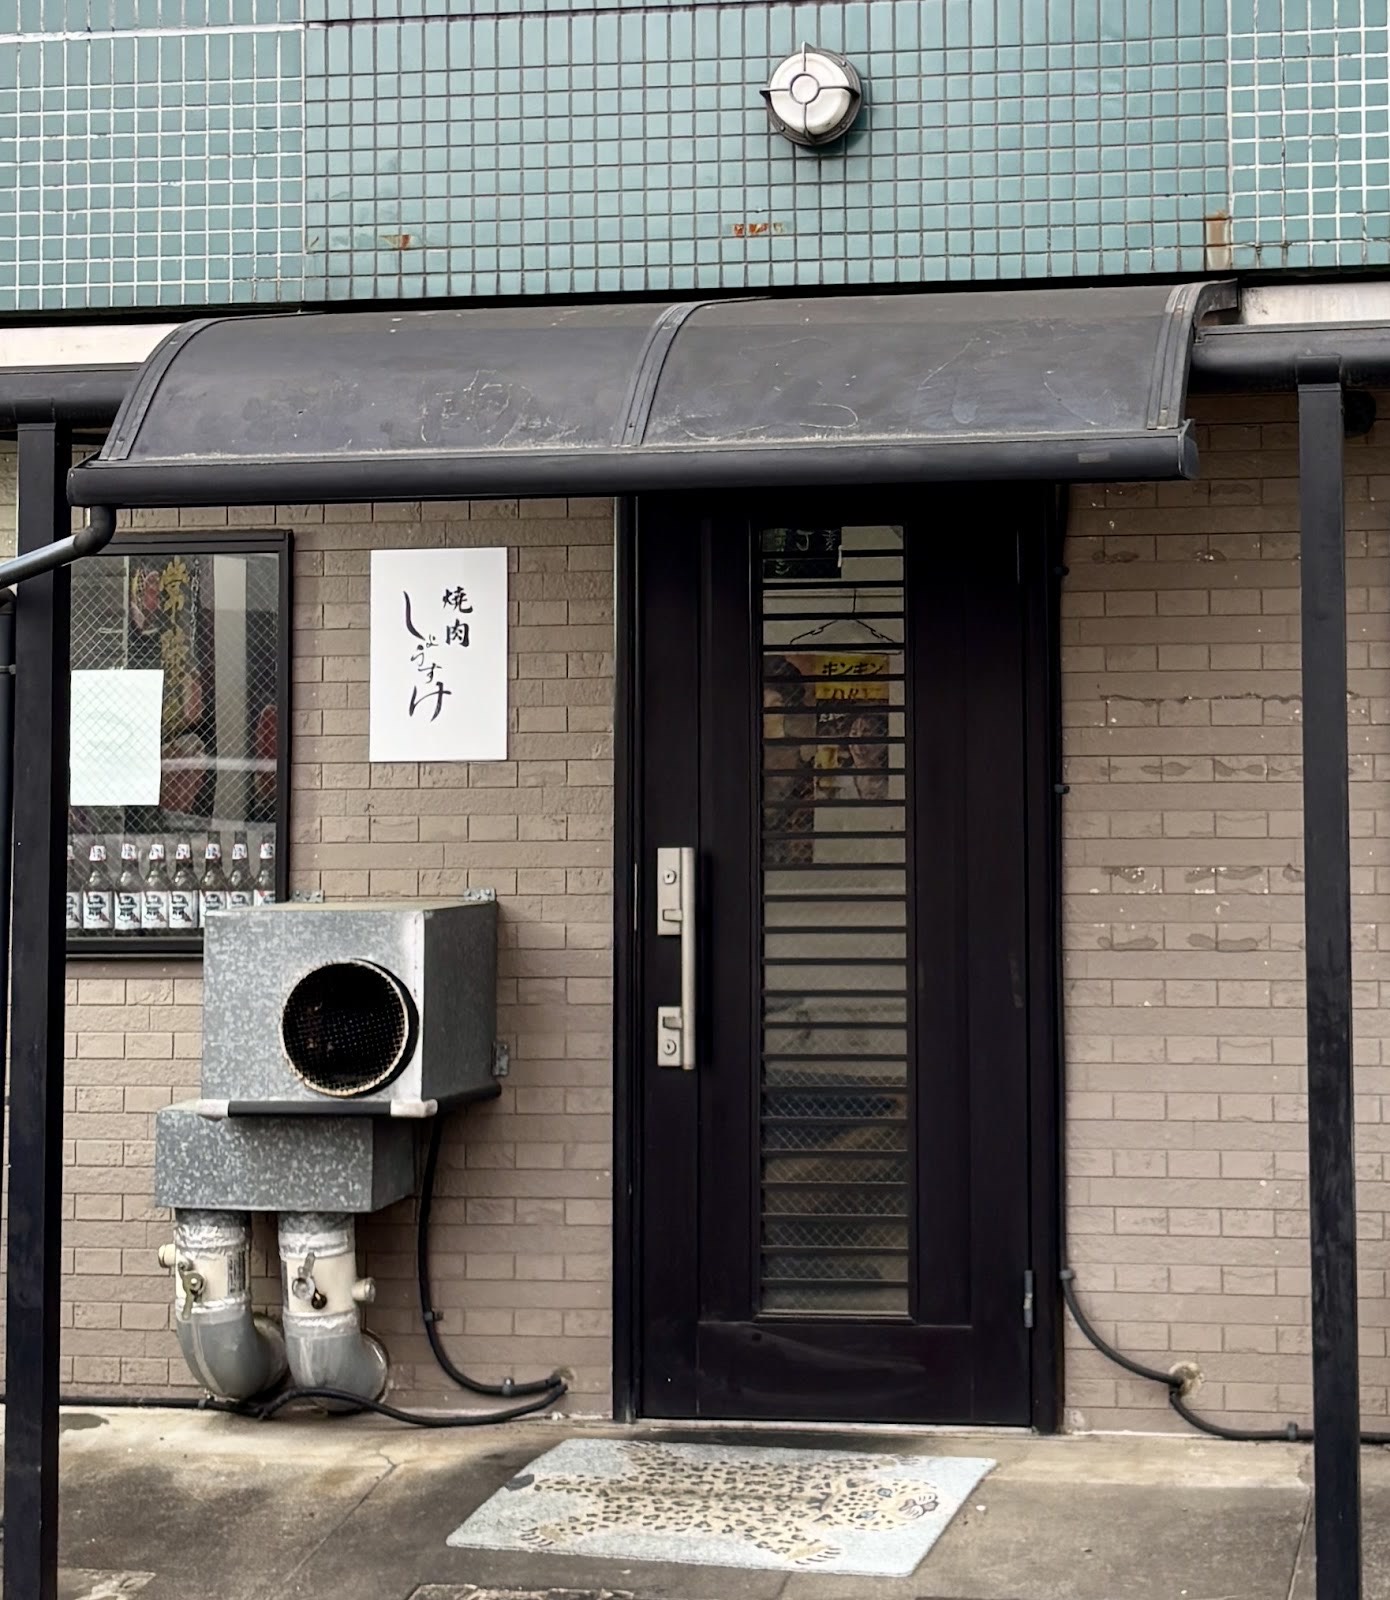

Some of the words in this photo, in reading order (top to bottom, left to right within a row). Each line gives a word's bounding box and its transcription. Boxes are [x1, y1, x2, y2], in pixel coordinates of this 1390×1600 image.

[402, 590, 452, 722] しょうすけ
[442, 586, 473, 648] 焼肉
